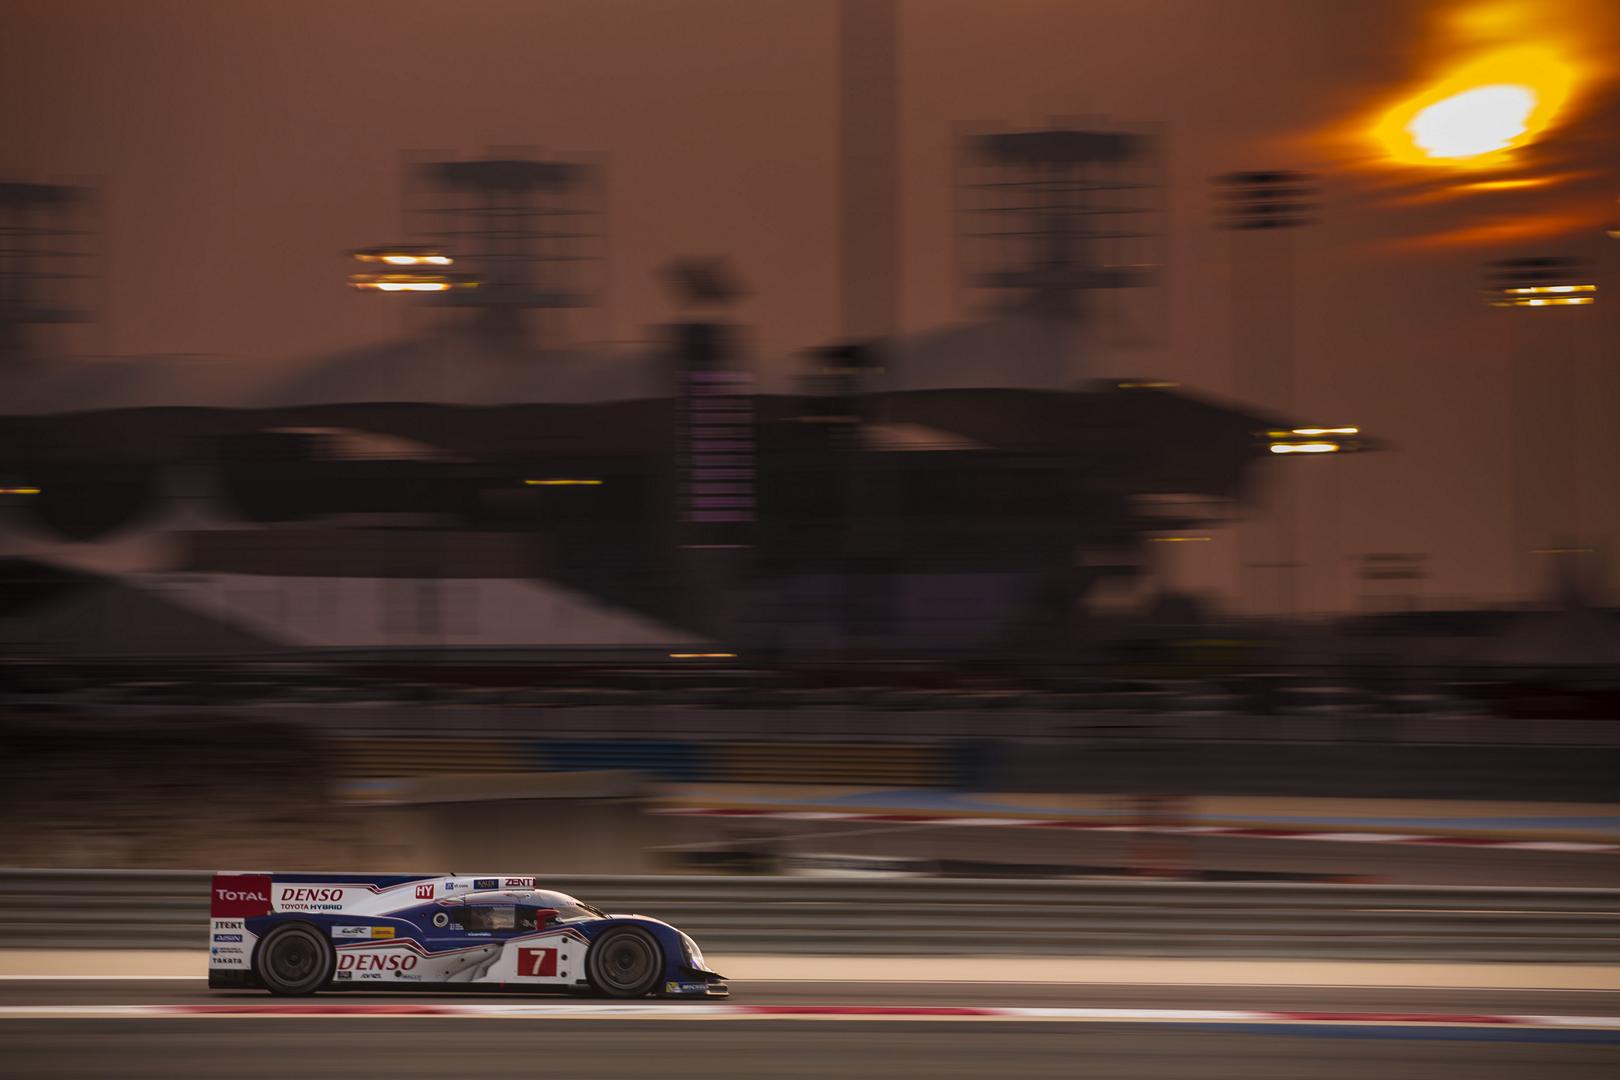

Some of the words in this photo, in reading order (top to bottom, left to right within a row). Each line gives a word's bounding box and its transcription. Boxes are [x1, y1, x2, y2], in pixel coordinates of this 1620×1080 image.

[505, 878, 532, 887] ZENT
[215, 889, 268, 901] TOTAL
[281, 888, 344, 902] DENSO
[416, 885, 433, 897] HY
[215, 921, 243, 929] JTEKT
[338, 954, 418, 970] DENSO
[530, 950, 546, 975] 7
